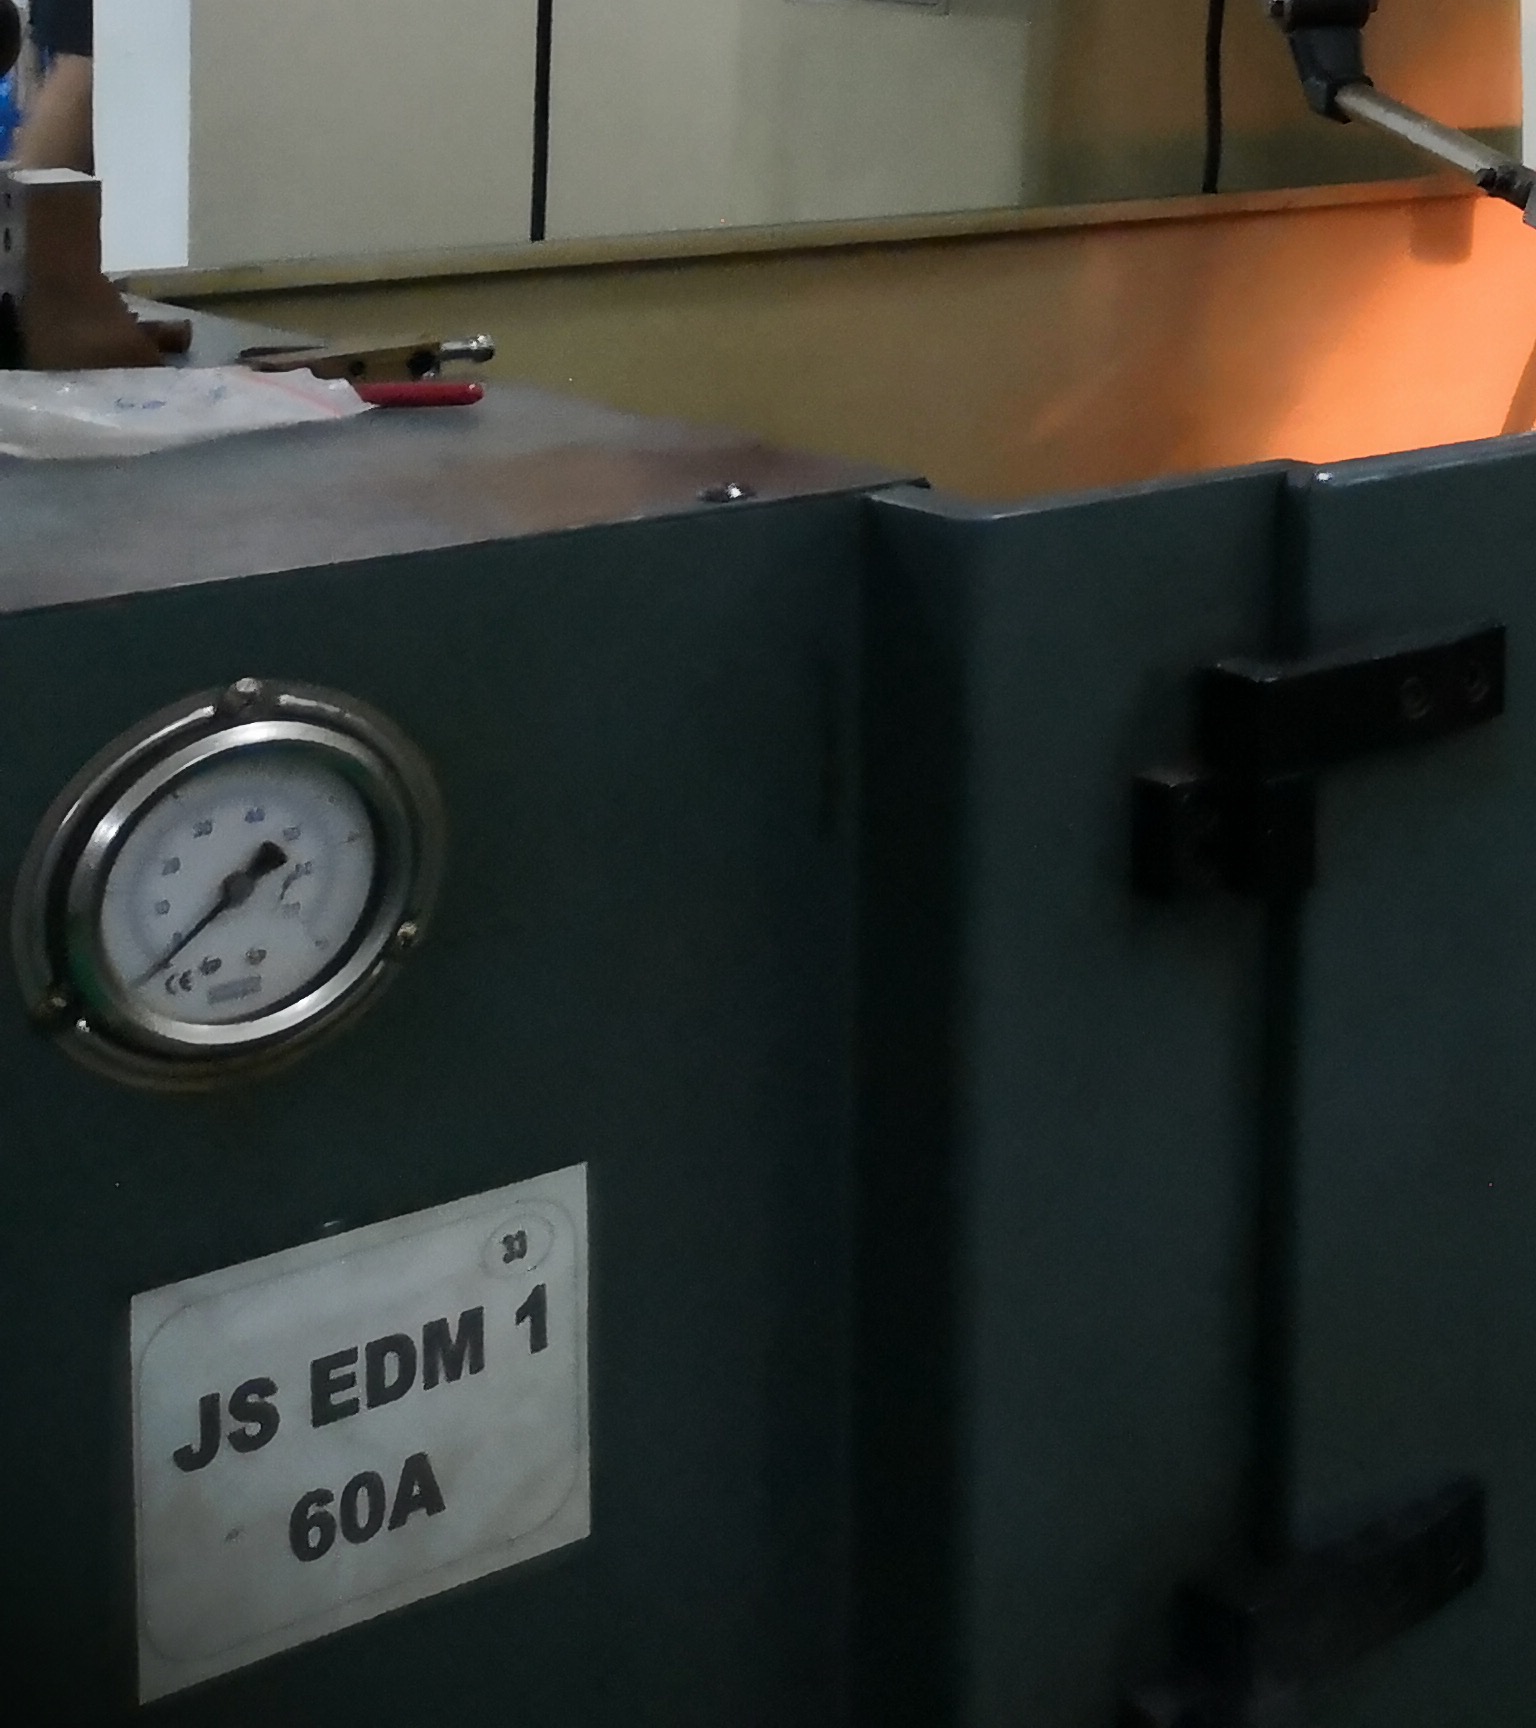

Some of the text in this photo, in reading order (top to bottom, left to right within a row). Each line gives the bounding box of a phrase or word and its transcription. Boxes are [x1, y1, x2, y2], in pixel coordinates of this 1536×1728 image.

[173, 1284, 548, 1473] JS EDM 1
[289, 1451, 446, 1561] 60A
